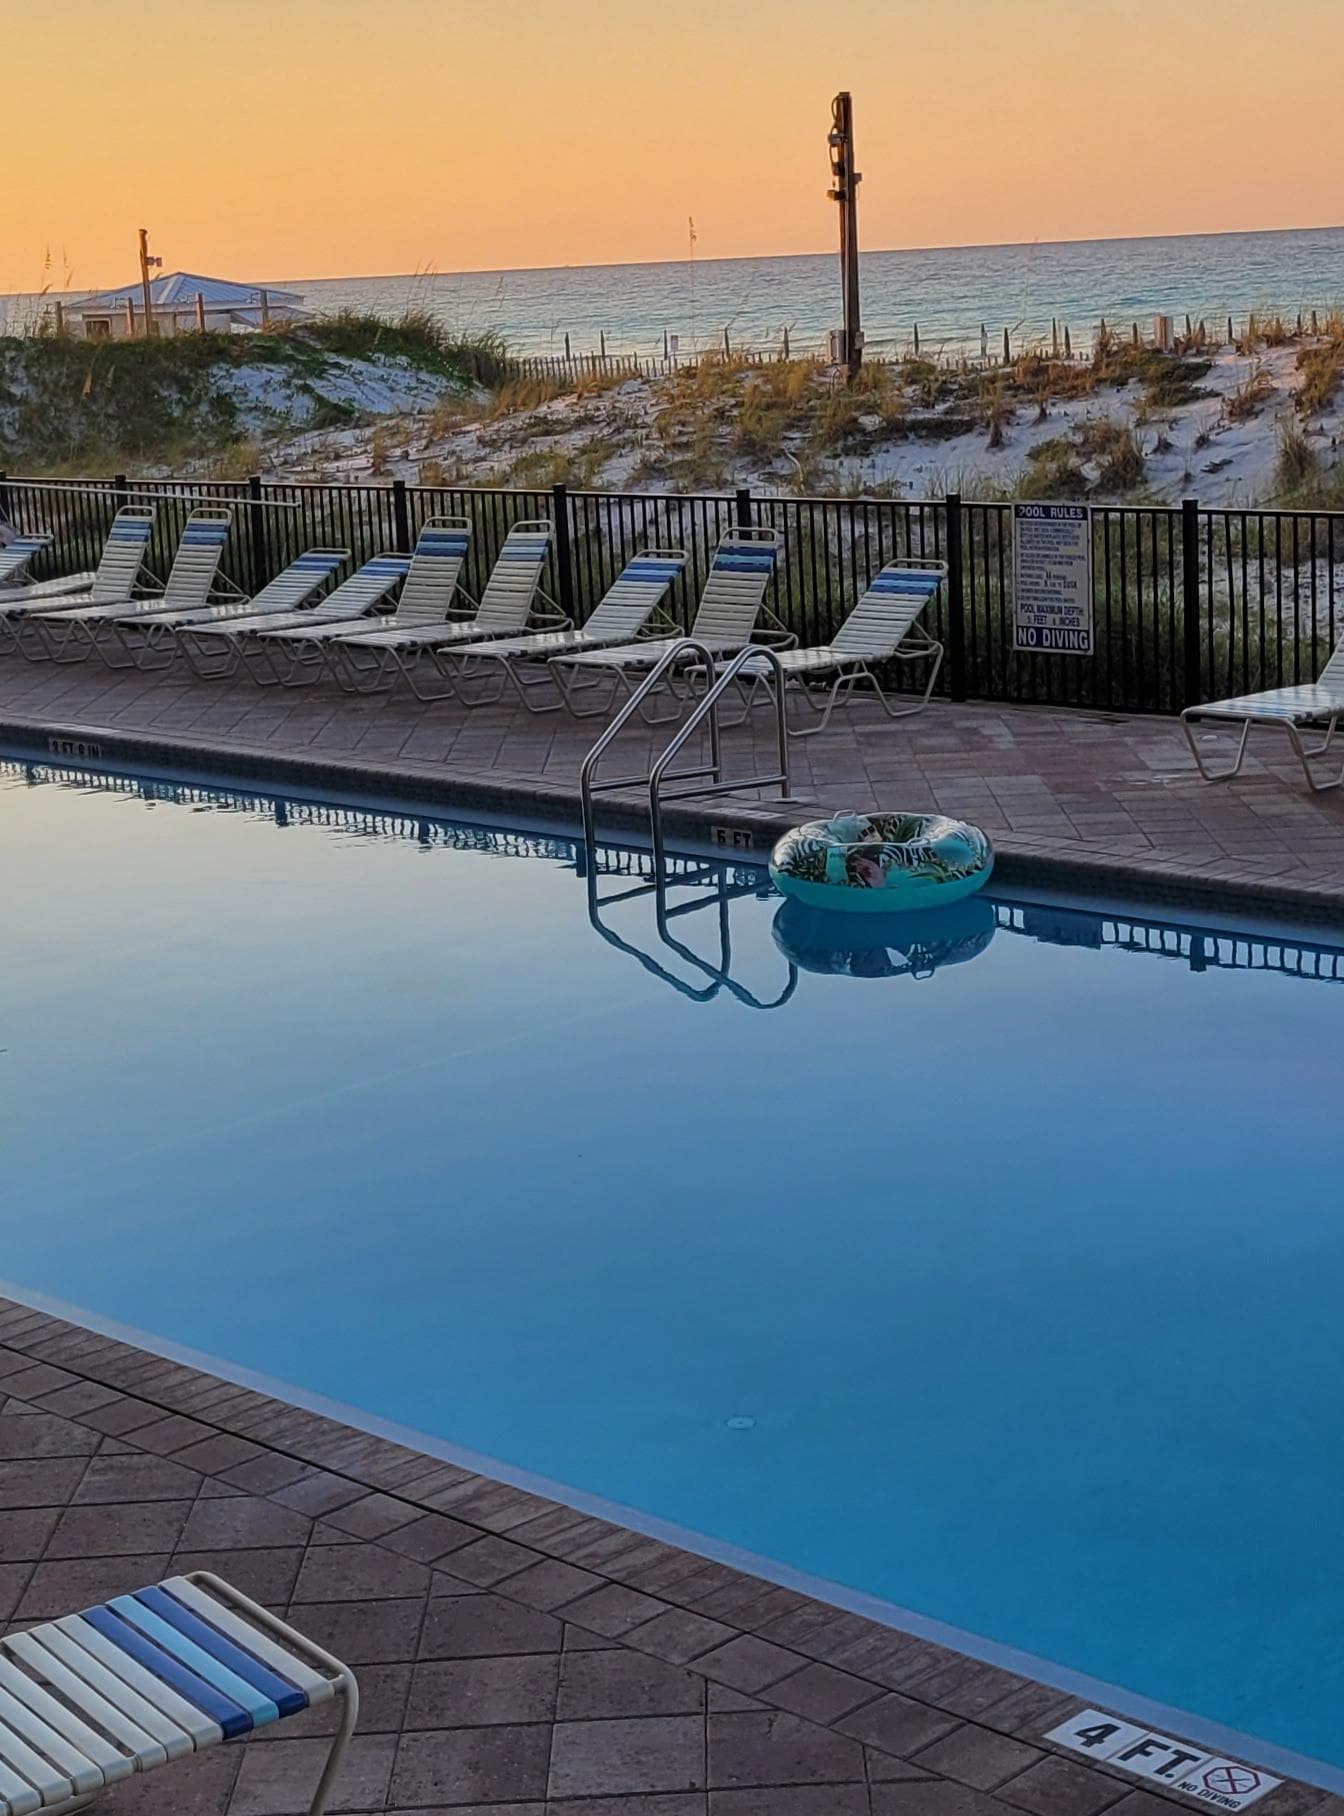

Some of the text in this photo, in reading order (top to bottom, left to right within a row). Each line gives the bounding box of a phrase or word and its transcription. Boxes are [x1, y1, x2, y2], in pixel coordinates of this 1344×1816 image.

[1018, 506, 1083, 519] POOL RULES
[1018, 627, 1089, 649] NO DIVING
[733, 831, 752, 848] FT
[1073, 1722, 1202, 1779] 4 FT.
[1177, 1781, 1241, 1809] NO DIVING
